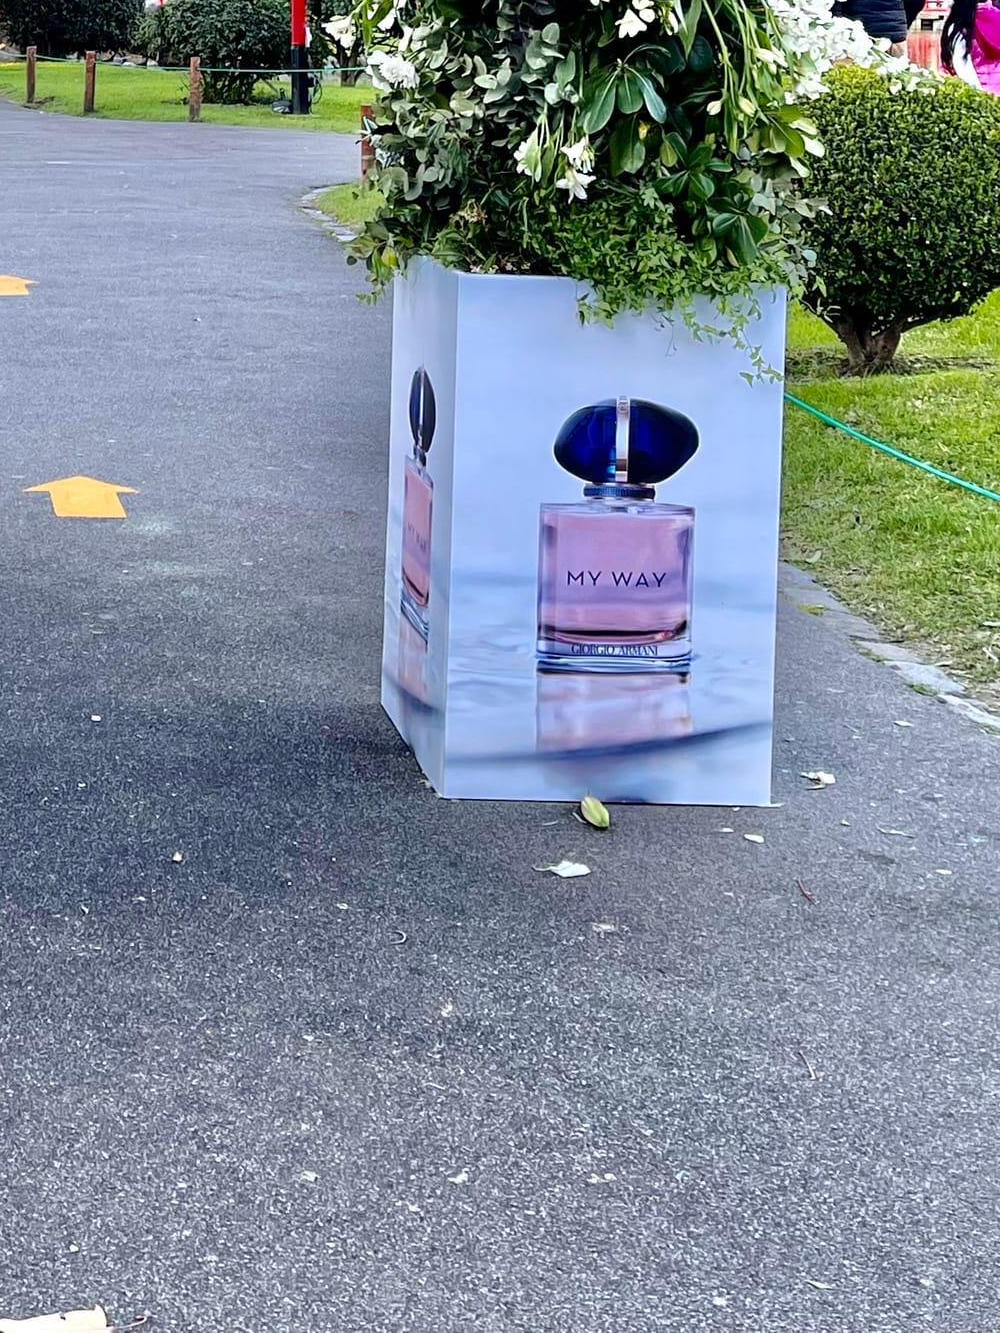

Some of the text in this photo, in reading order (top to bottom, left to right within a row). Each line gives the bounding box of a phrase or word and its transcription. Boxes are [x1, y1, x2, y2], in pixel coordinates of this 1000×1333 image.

[567, 570, 667, 588] MY WAY
[571, 644, 658, 656] GIORGIO ARMANI
